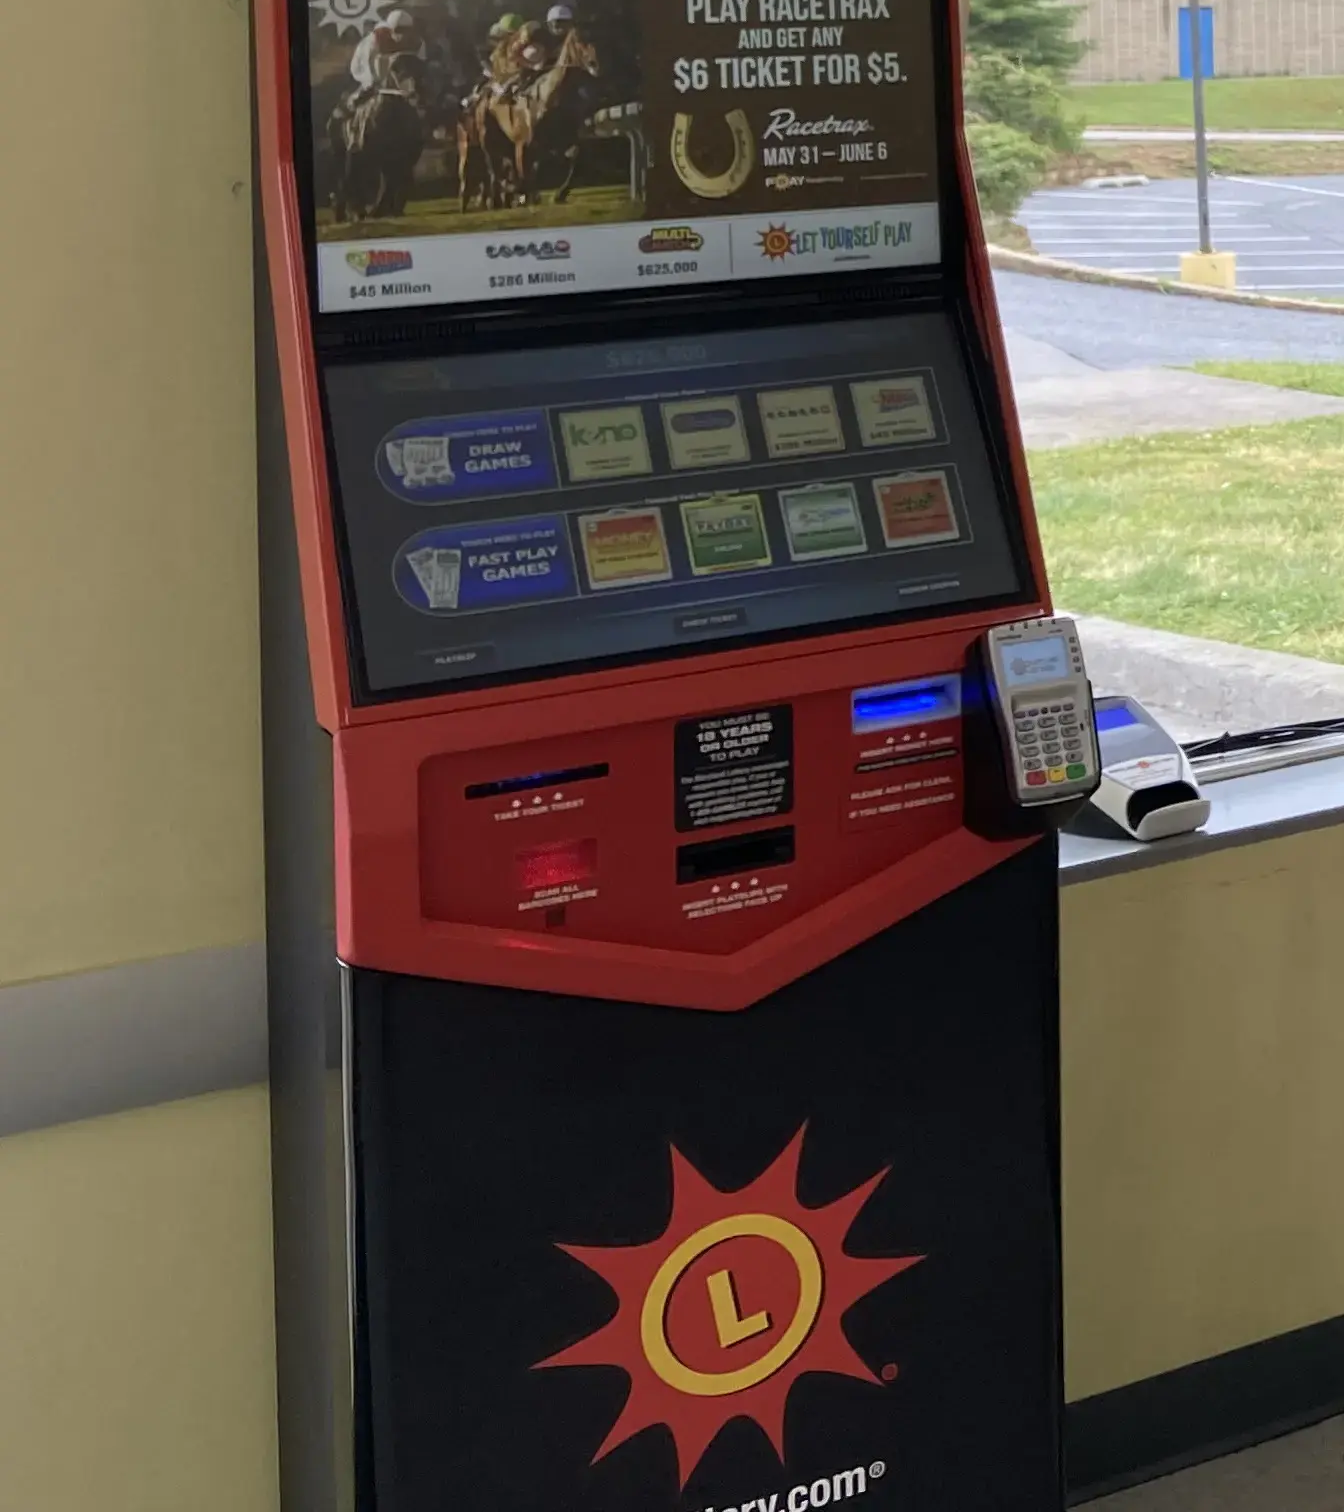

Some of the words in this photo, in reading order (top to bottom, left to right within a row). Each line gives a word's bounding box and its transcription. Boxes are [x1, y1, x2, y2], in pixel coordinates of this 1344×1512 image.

[738, 28, 772, 49] AND
[776, 27, 806, 48] GET
[812, 26, 843, 47] ANY
[674, 57, 709, 93] $6
[715, 56, 806, 88] TICKET
[813, 54, 860, 85] FOR
[867, 52, 908, 84] $5.
[763, 108, 869, 140] Racetrax
[764, 147, 797, 166] MAY
[839, 143, 874, 162] JUNE
[878, 142, 887, 160] 6
[797, 232, 818, 254] LET
[820, 221, 881, 250] YOURSELF
[884, 221, 912, 247] PLAY
[469, 442, 522, 457] DRAW
[465, 455, 532, 473] GAMES
[469, 551, 512, 568] FAST
[516, 546, 558, 561] PLAY
[482, 562, 551, 582] GAMES
[720, 722, 773, 738] YEARS
